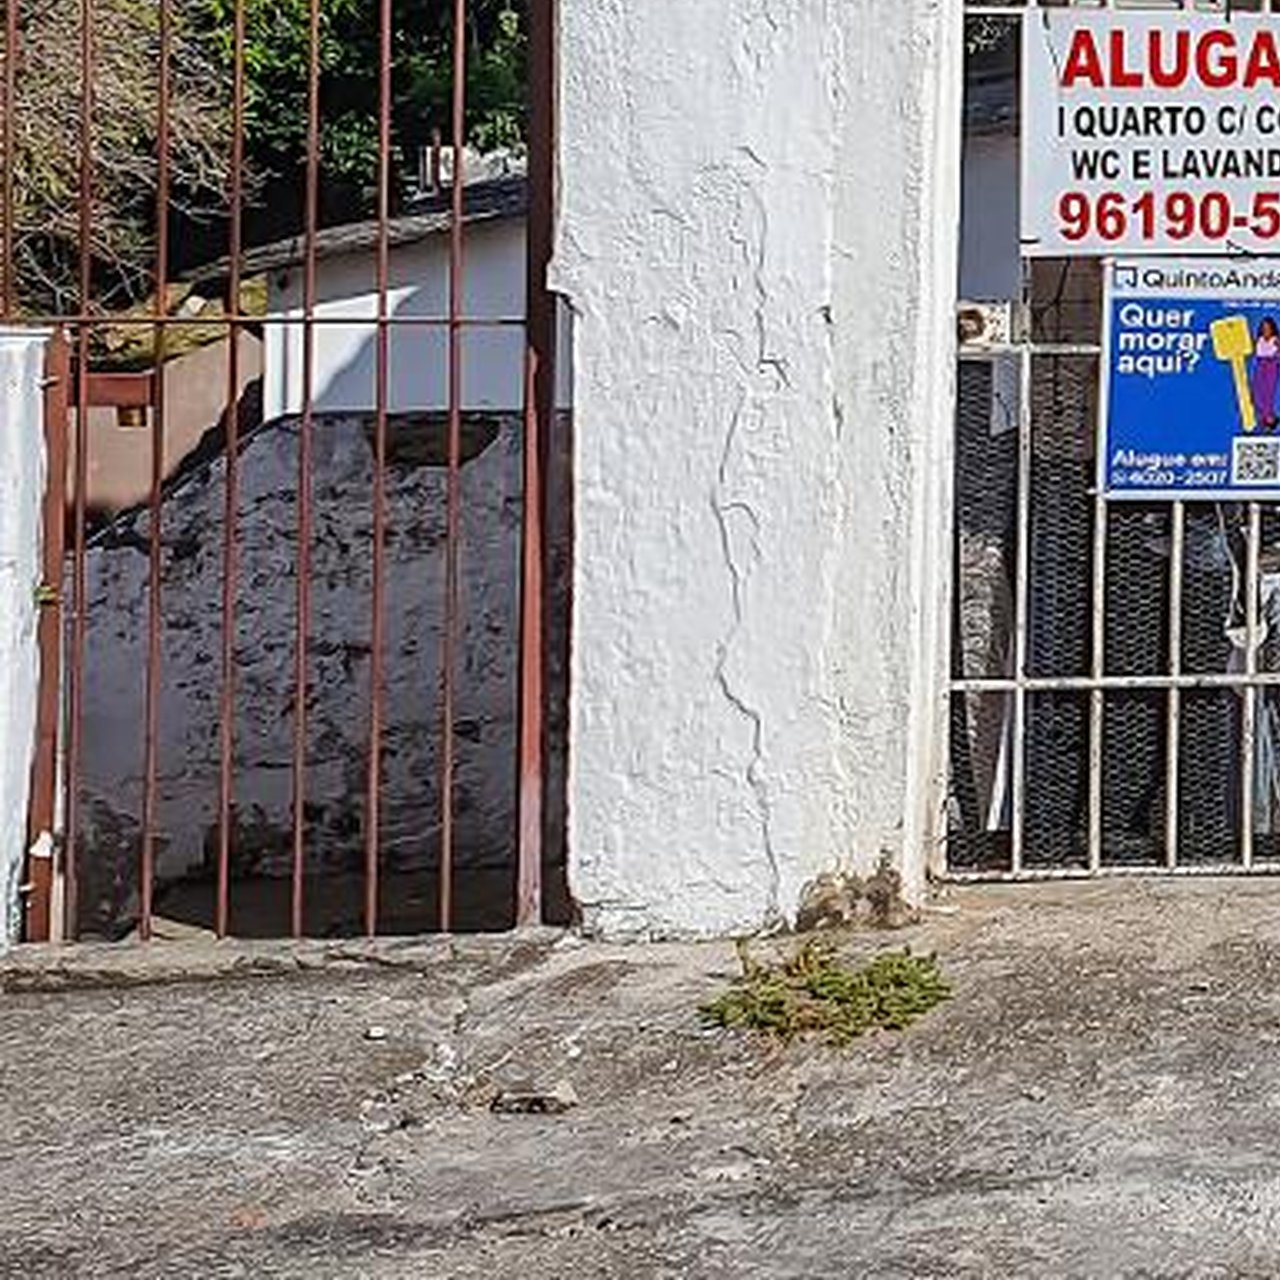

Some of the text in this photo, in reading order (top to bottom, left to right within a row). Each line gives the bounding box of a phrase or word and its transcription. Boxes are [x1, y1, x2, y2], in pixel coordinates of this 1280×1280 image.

[1074, 105, 1206, 139] QUARTO
[1218, 105, 1245, 137] C/
[1072, 149, 1120, 180] WC
[1133, 149, 1150, 180] E
[1118, 302, 1196, 328] Quer
[1118, 331, 1208, 352] morar
[1117, 350, 1201, 380] aqui?
[1112, 449, 1187, 470] Alugue
